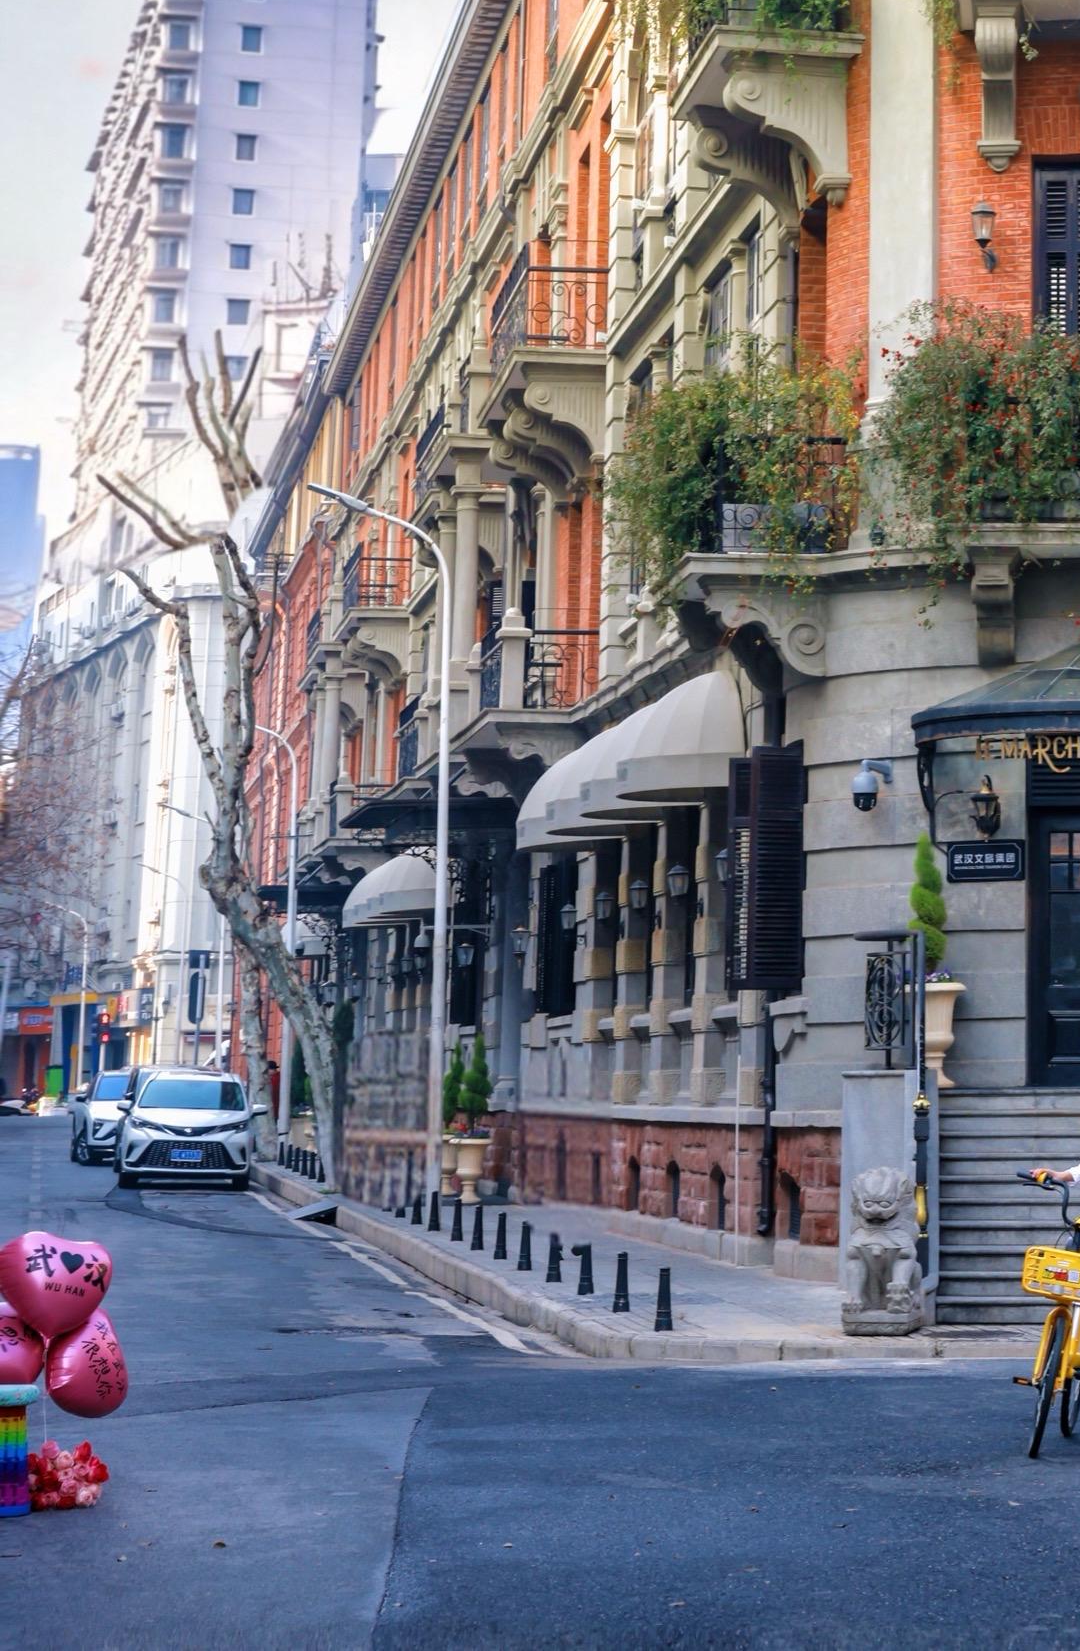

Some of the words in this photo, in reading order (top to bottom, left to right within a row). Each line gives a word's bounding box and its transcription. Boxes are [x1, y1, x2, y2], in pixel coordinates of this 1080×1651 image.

[26, 1244, 57, 1278] 武
[44, 1282, 61, 1292] WU
[64, 1285, 86, 1297] HAN
